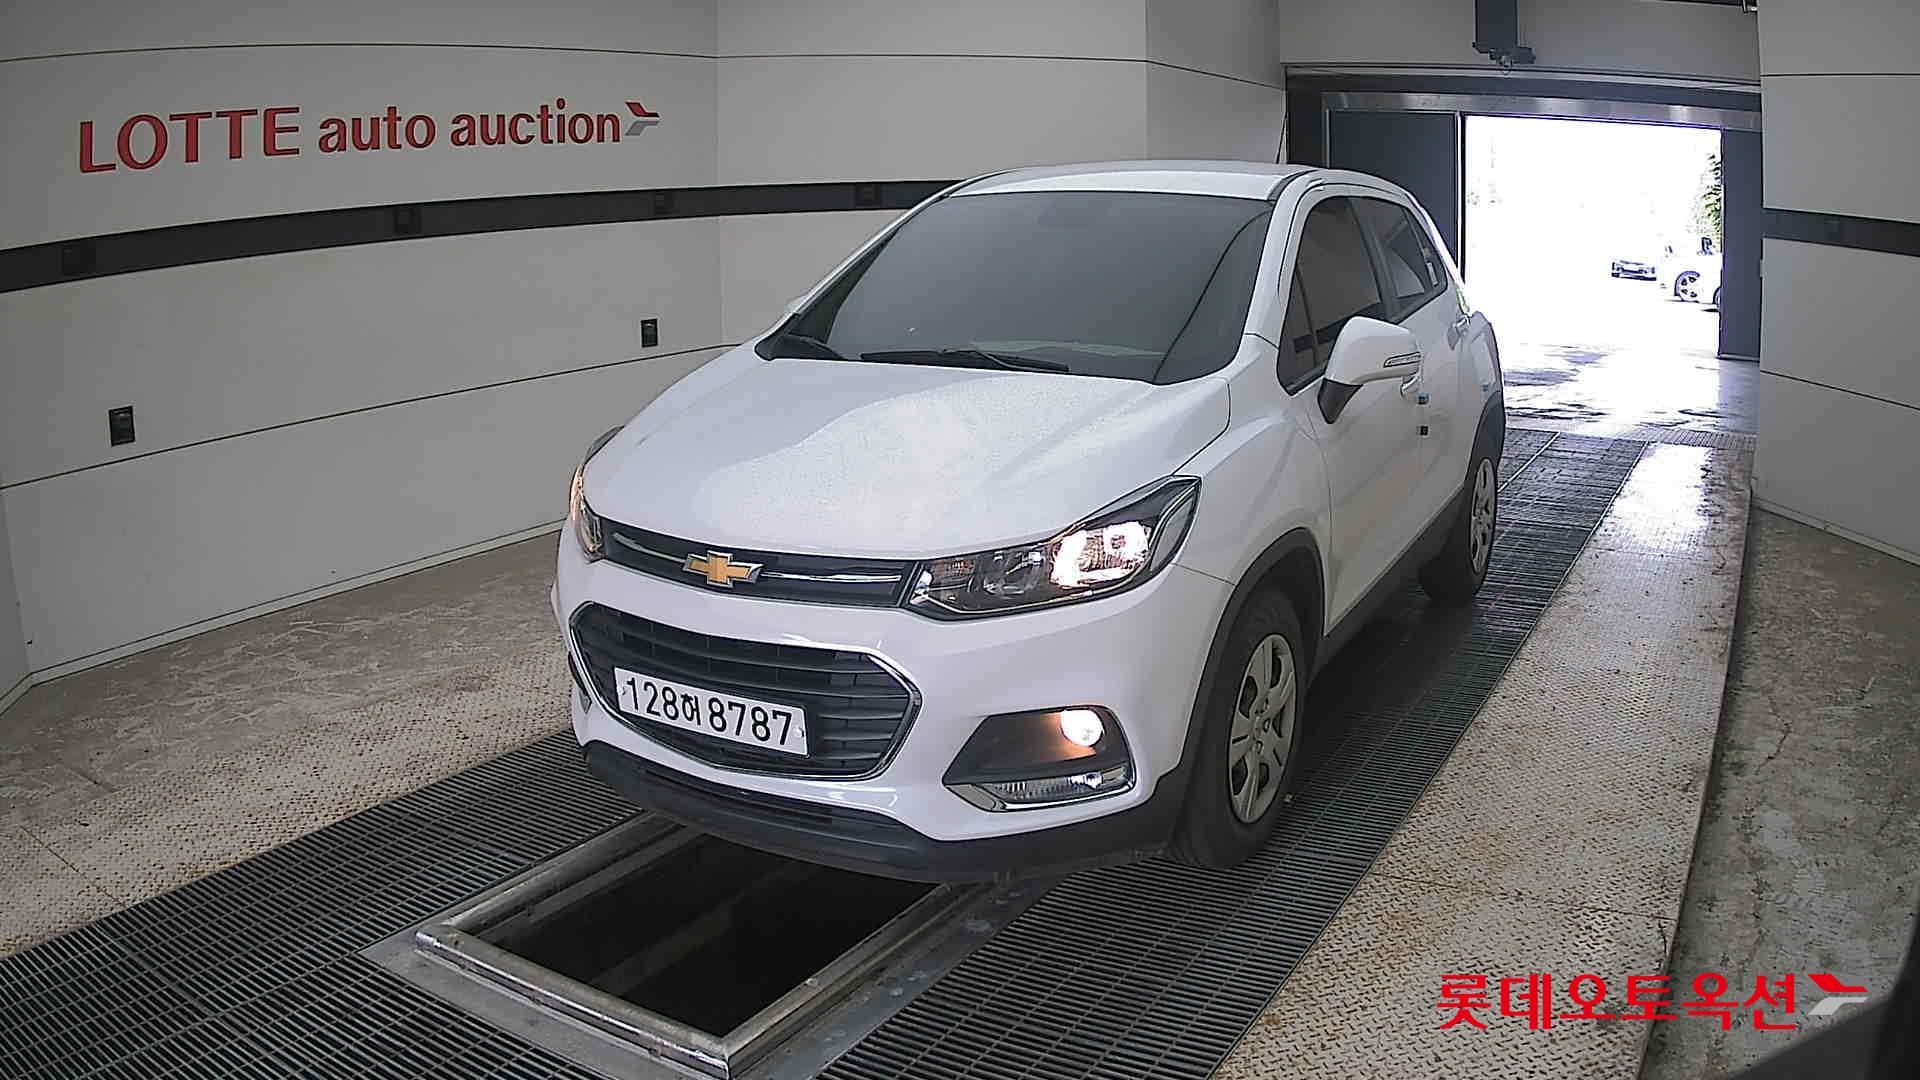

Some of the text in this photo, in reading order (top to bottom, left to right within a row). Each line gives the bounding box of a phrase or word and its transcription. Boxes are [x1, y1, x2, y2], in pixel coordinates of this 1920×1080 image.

[79, 98, 622, 173] LOTTE auto auction
